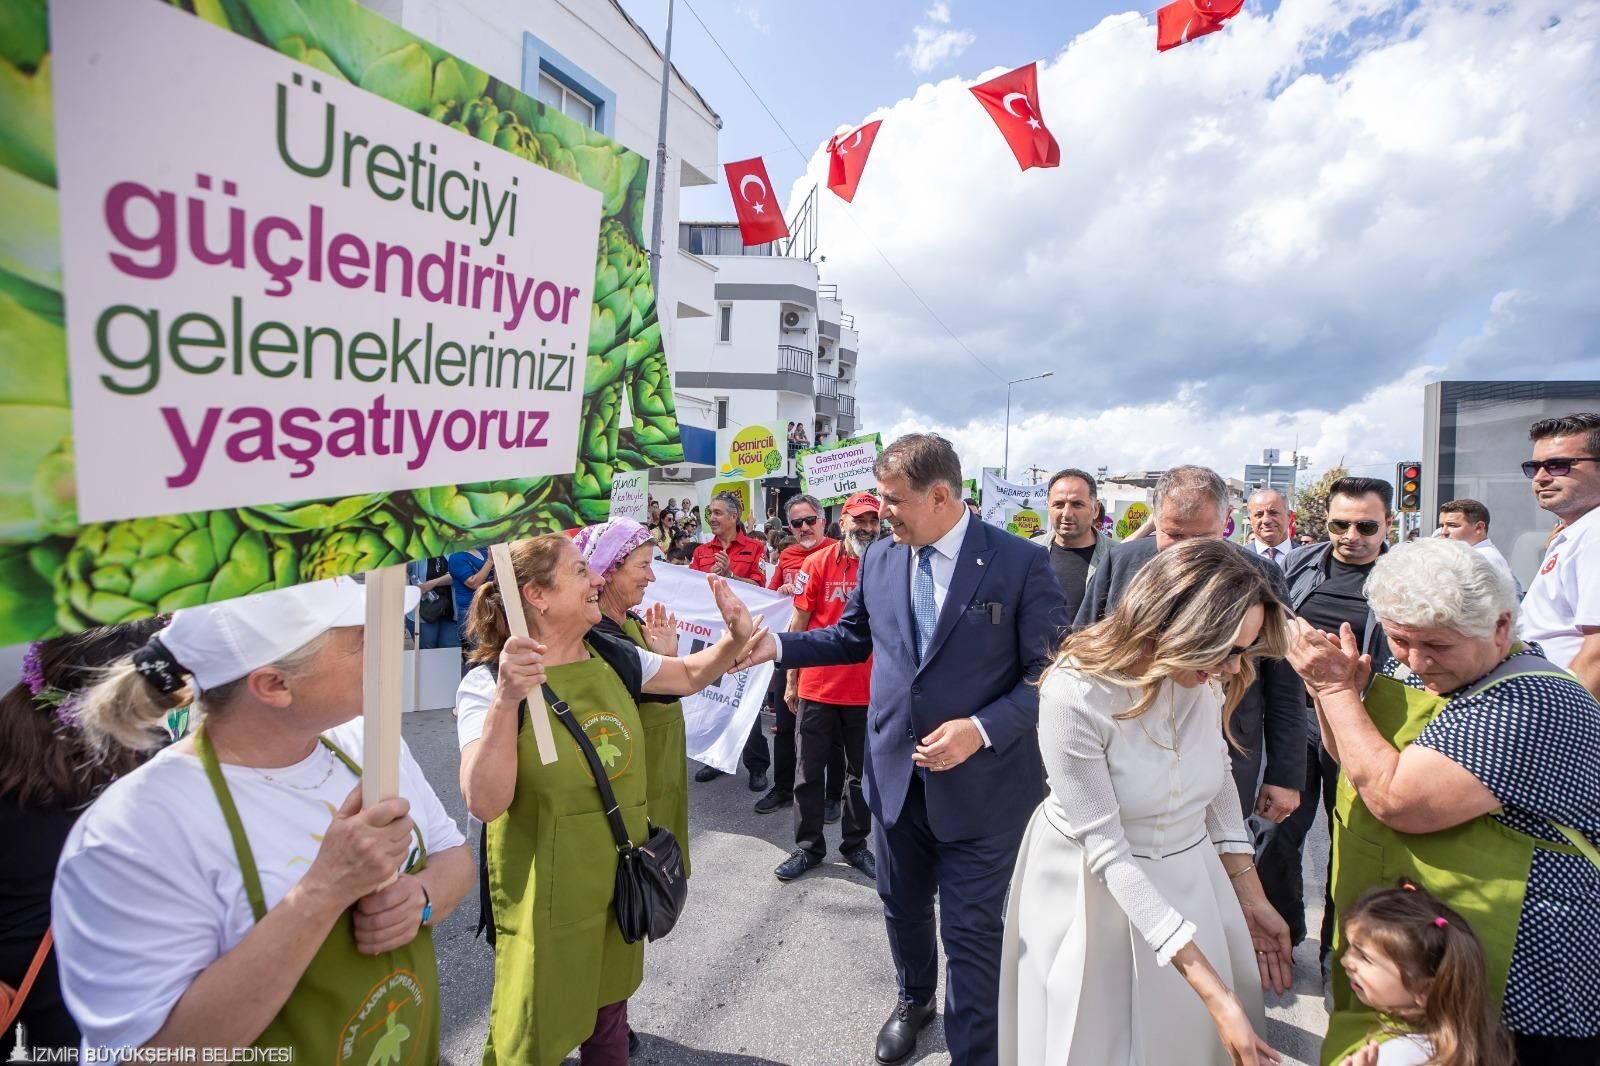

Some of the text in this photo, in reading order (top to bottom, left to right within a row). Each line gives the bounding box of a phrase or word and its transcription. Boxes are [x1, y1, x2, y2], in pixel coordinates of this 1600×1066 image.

[276, 73, 518, 246] Üreticiyi
[103, 173, 581, 331] güçlendiriyor
[94, 296, 577, 395] geleneklerimizi
[160, 394, 551, 489] yaşatıyoruz
[732, 435, 774, 453] Demircili
[738, 450, 762, 465] Köyü
[815, 446, 864, 465] Gastronomi
[834, 480, 857, 493] Urla
